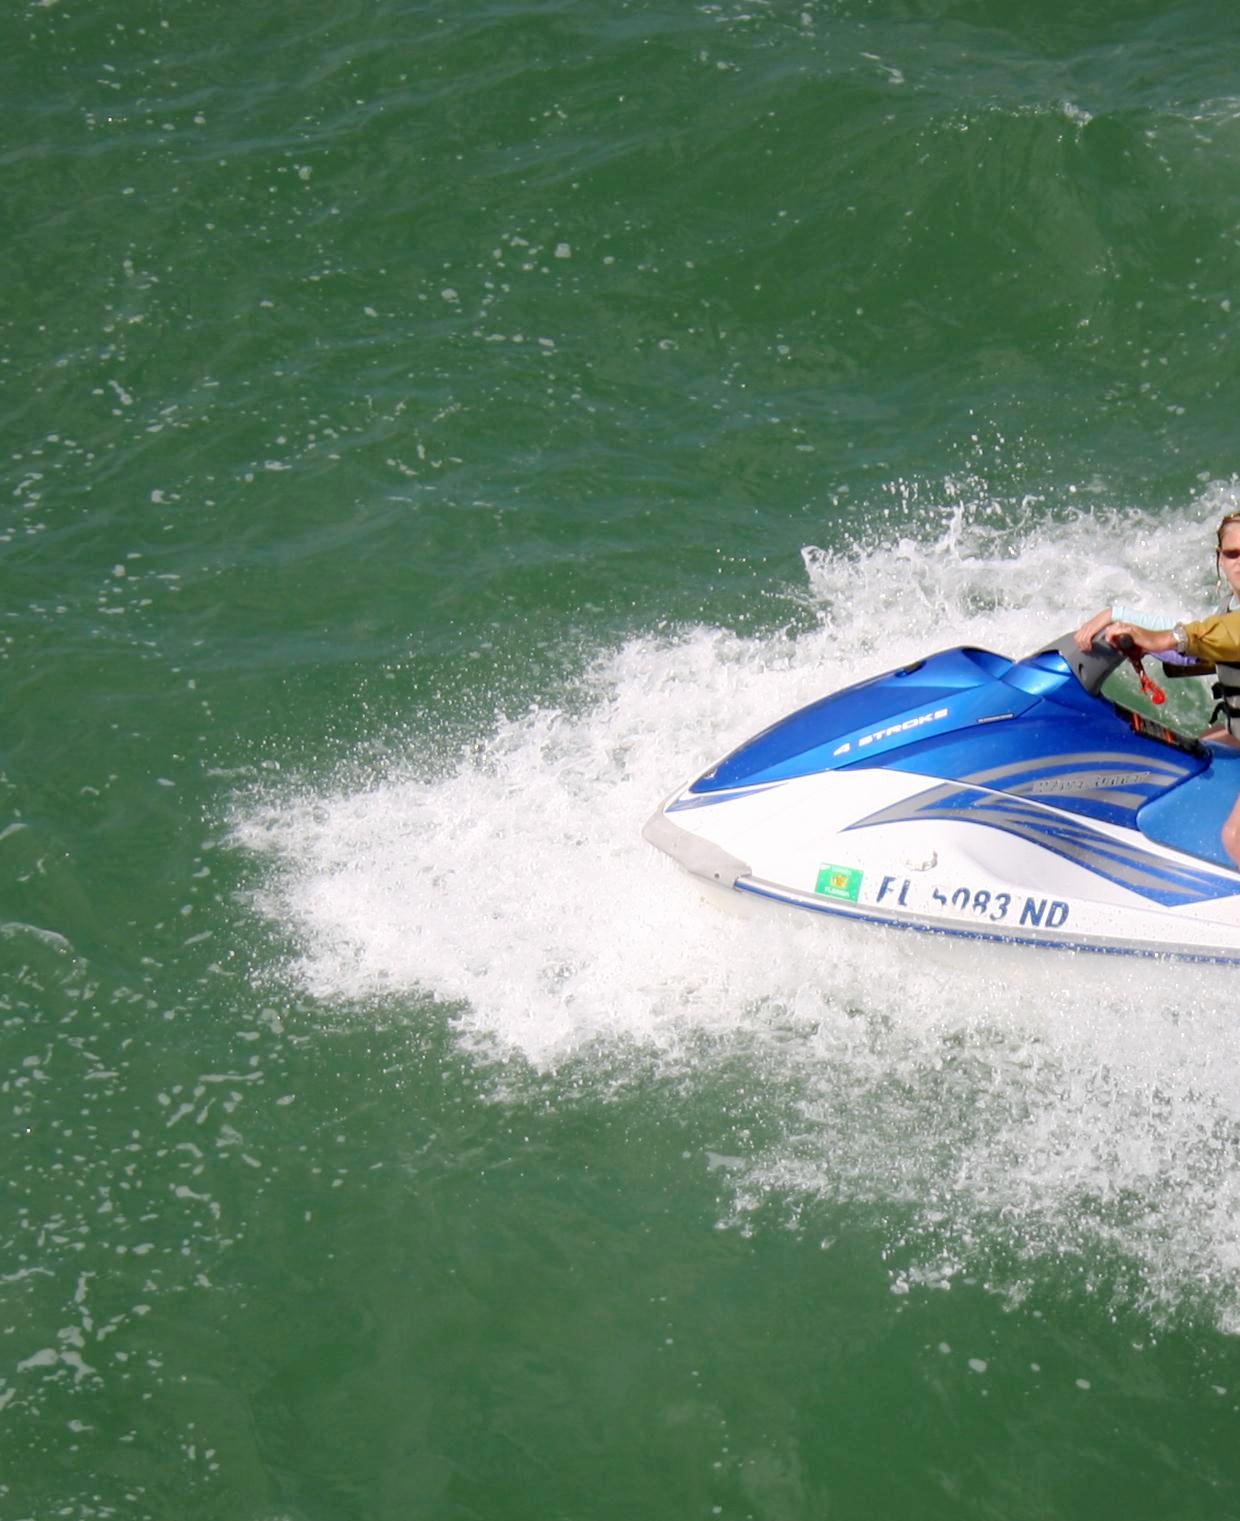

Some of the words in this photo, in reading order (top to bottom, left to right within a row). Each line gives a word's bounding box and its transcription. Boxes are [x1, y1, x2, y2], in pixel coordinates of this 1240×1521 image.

[833, 742, 851, 756] 4
[858, 708, 949, 747] STROKE
[876, 876, 911, 907] FL
[1019, 897, 1070, 928] ND
